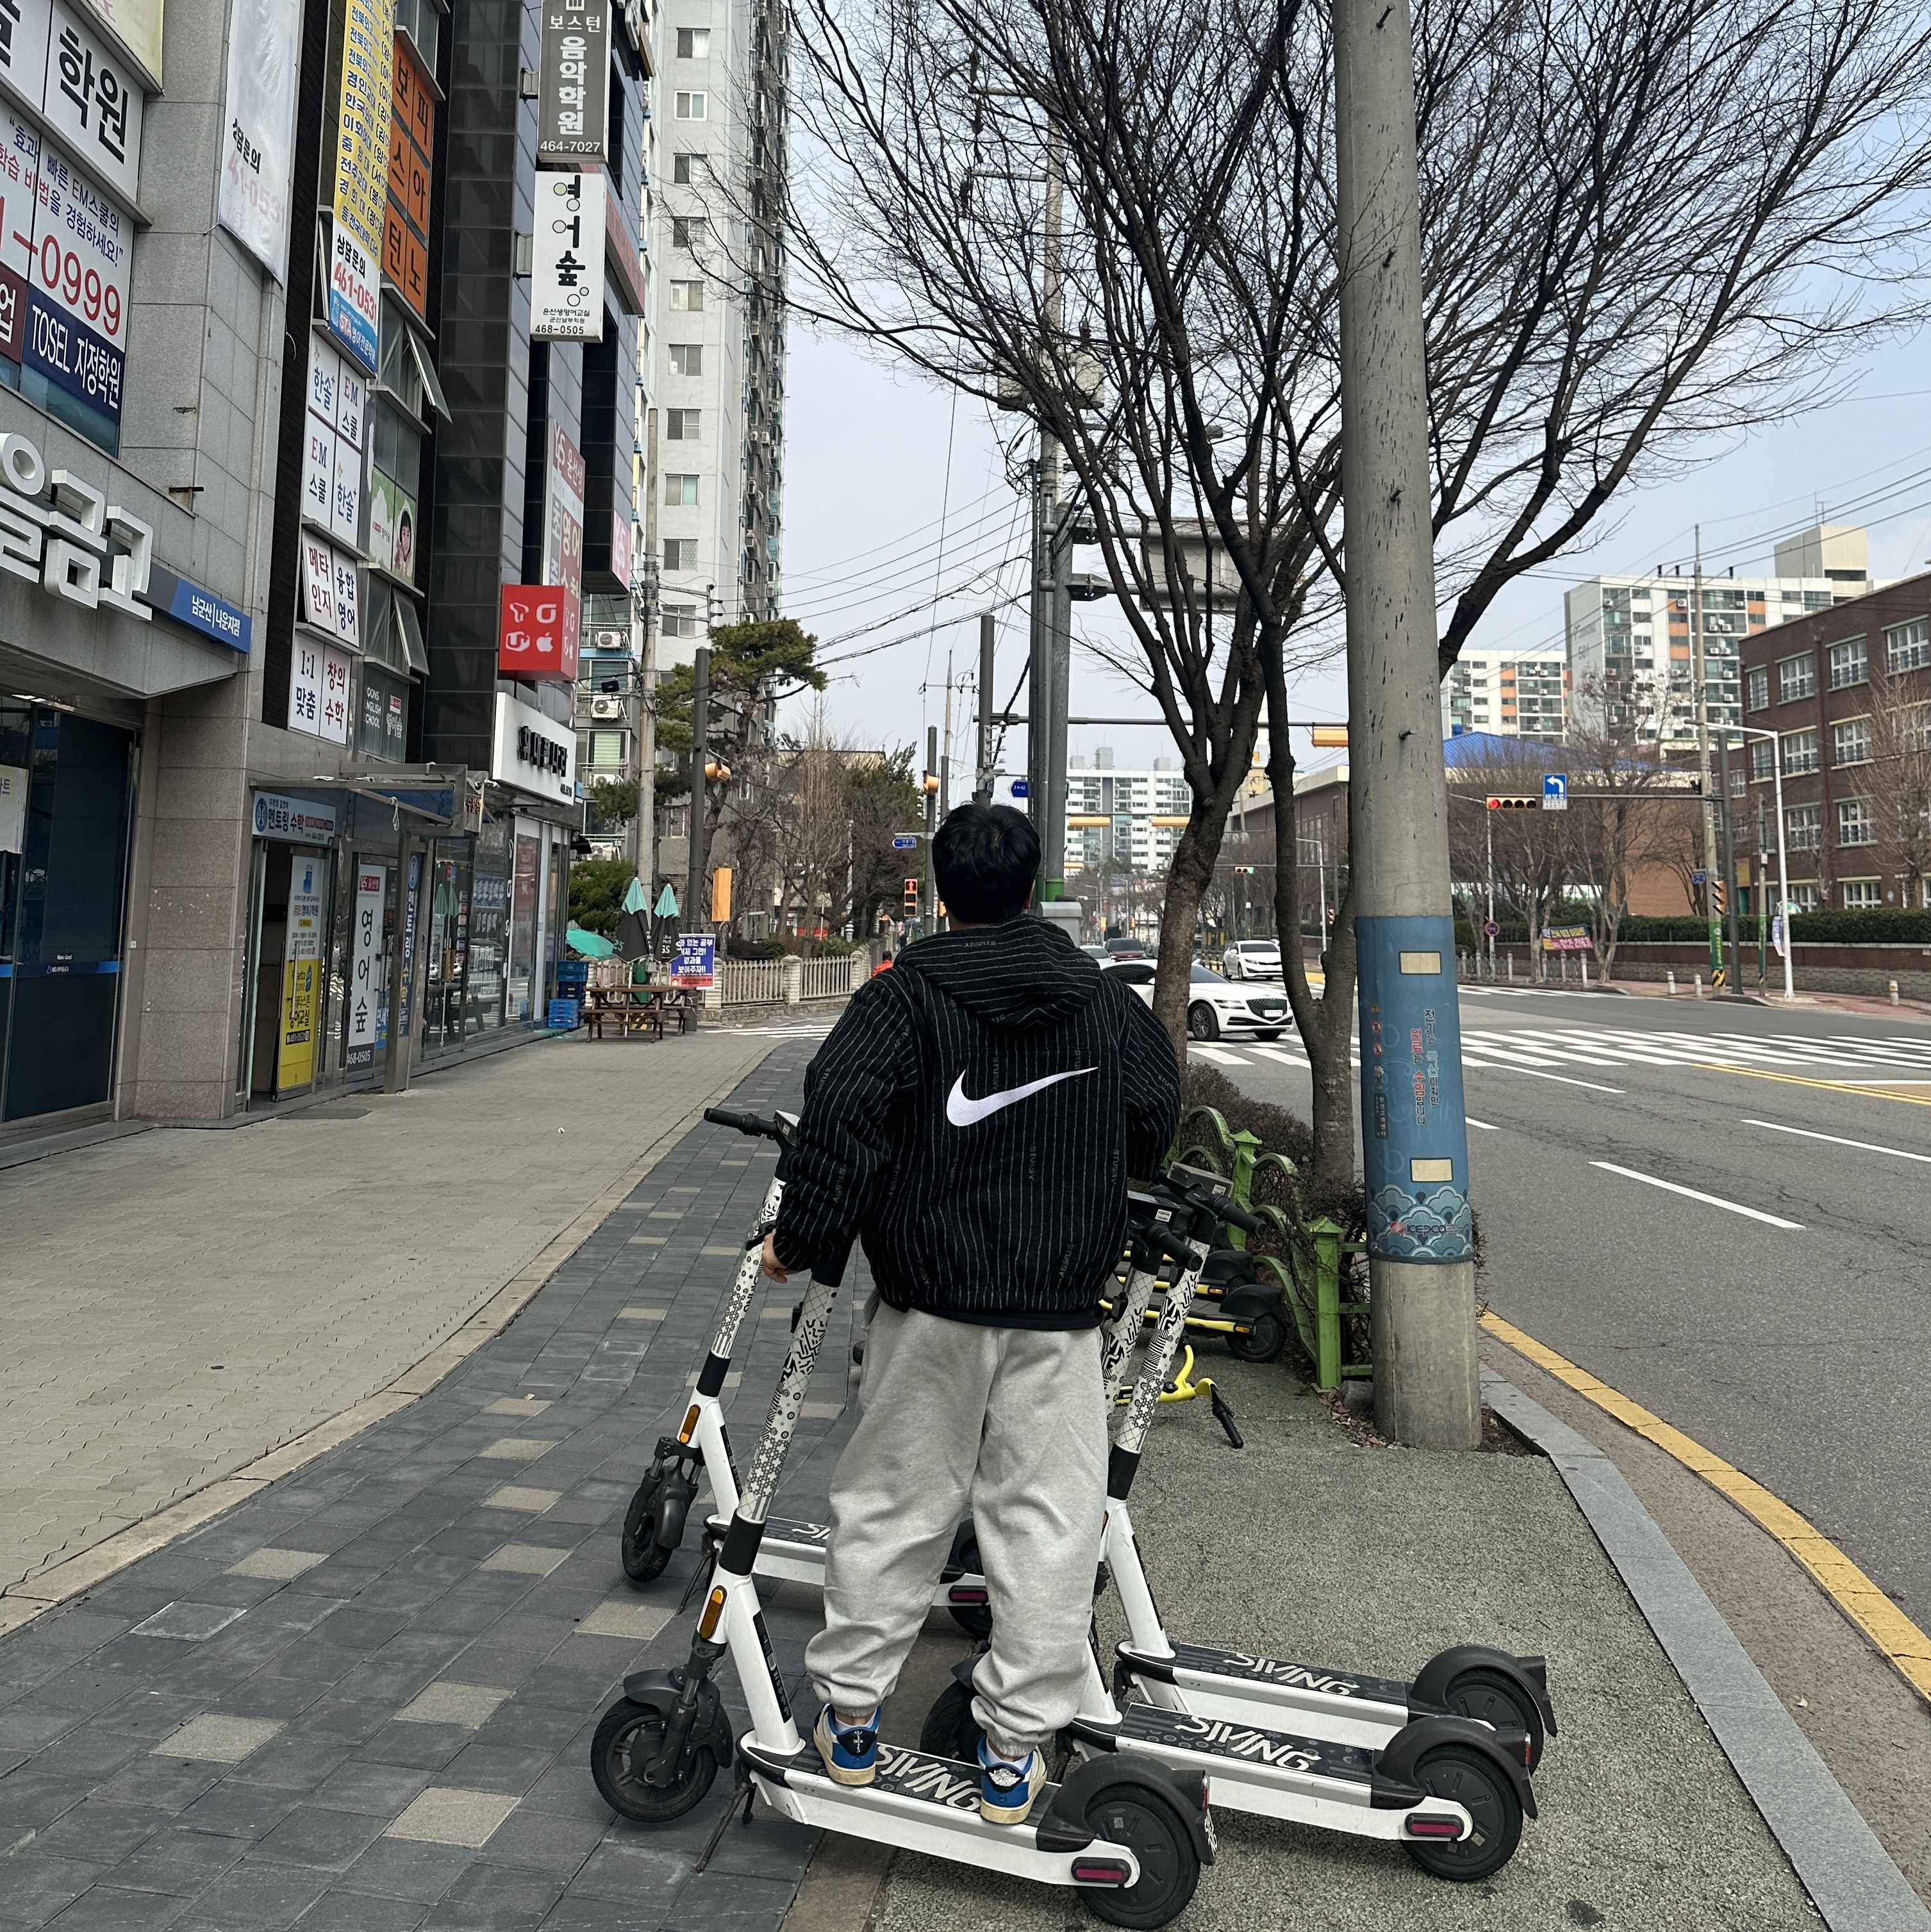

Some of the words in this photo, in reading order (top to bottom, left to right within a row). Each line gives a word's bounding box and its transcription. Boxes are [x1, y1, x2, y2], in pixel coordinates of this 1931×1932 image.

[549, 15, 600, 33] 보스턴
[60, 26, 128, 165] 학원
[558, 36, 587, 135] 음악학원
[540, 141, 601, 153] 464-7027
[389, 56, 408, 277] 보스턴
[24, 167, 61, 217] 비법을
[47, 154, 68, 192] 빠른
[72, 178, 119, 238] EM스쿨의
[410, 91, 428, 296] 피아노
[553, 175, 586, 286] 영어숲
[337, 233, 366, 279] 상담문의
[335, 261, 377, 326] 461-0531
[340, 311, 352, 340] STA
[535, 325, 584, 334] 468-0505
[32, 304, 70, 374] TOSEL
[74, 338, 121, 409] 지정학원
[344, 376, 358, 407] EM
[343, 410, 358, 441] 스쿨
[311, 436, 327, 468] EM
[309, 474, 326, 504] 스쿨
[563, 511, 581, 568] 영어
[308, 547, 329, 582] 메타
[311, 584, 331, 618] 인지
[336, 566, 354, 601] 융합
[338, 602, 356, 636] 영어
[301, 650, 315, 679] 1:1
[327, 661, 345, 695] 창의
[297, 687, 315, 720] 맞춤
[325, 698, 345, 729] 수학
[269, 809, 289, 832] 멘토링
[290, 813, 304, 834] 수학
[405, 891, 415, 958] 멘토링
[355, 909, 374, 1033] 영어숲
[401, 962, 410, 1006] 수학
[1424, 1009, 1436, 1044] 전기는
[347, 1050, 371, 1064] 468-0505
[1411, 1028, 1423, 1064] 원료는
[1426, 1051, 1439, 1106] 국산이지만
[1413, 1070, 1426, 1125] 수입입니다
